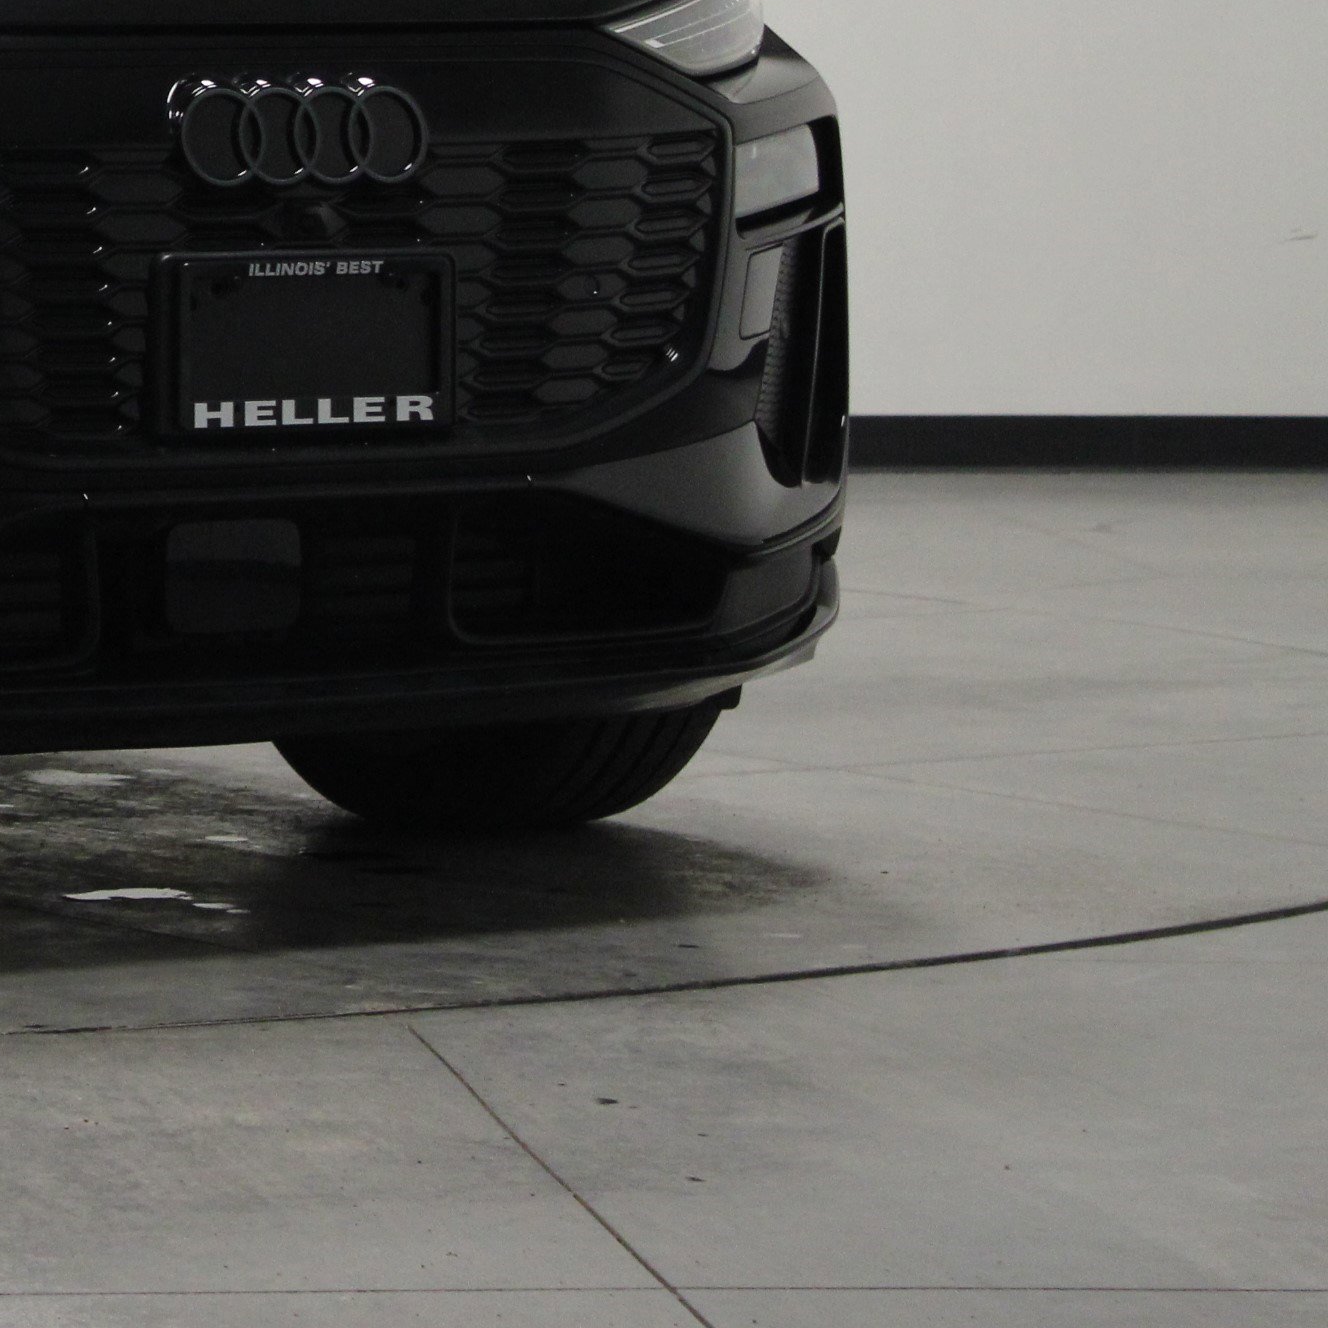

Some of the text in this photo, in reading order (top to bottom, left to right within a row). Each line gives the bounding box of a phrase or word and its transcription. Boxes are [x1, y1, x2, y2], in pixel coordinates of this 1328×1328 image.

[248, 260, 384, 277] ILLINOIS' BEST
[193, 394, 434, 429] HELLER
